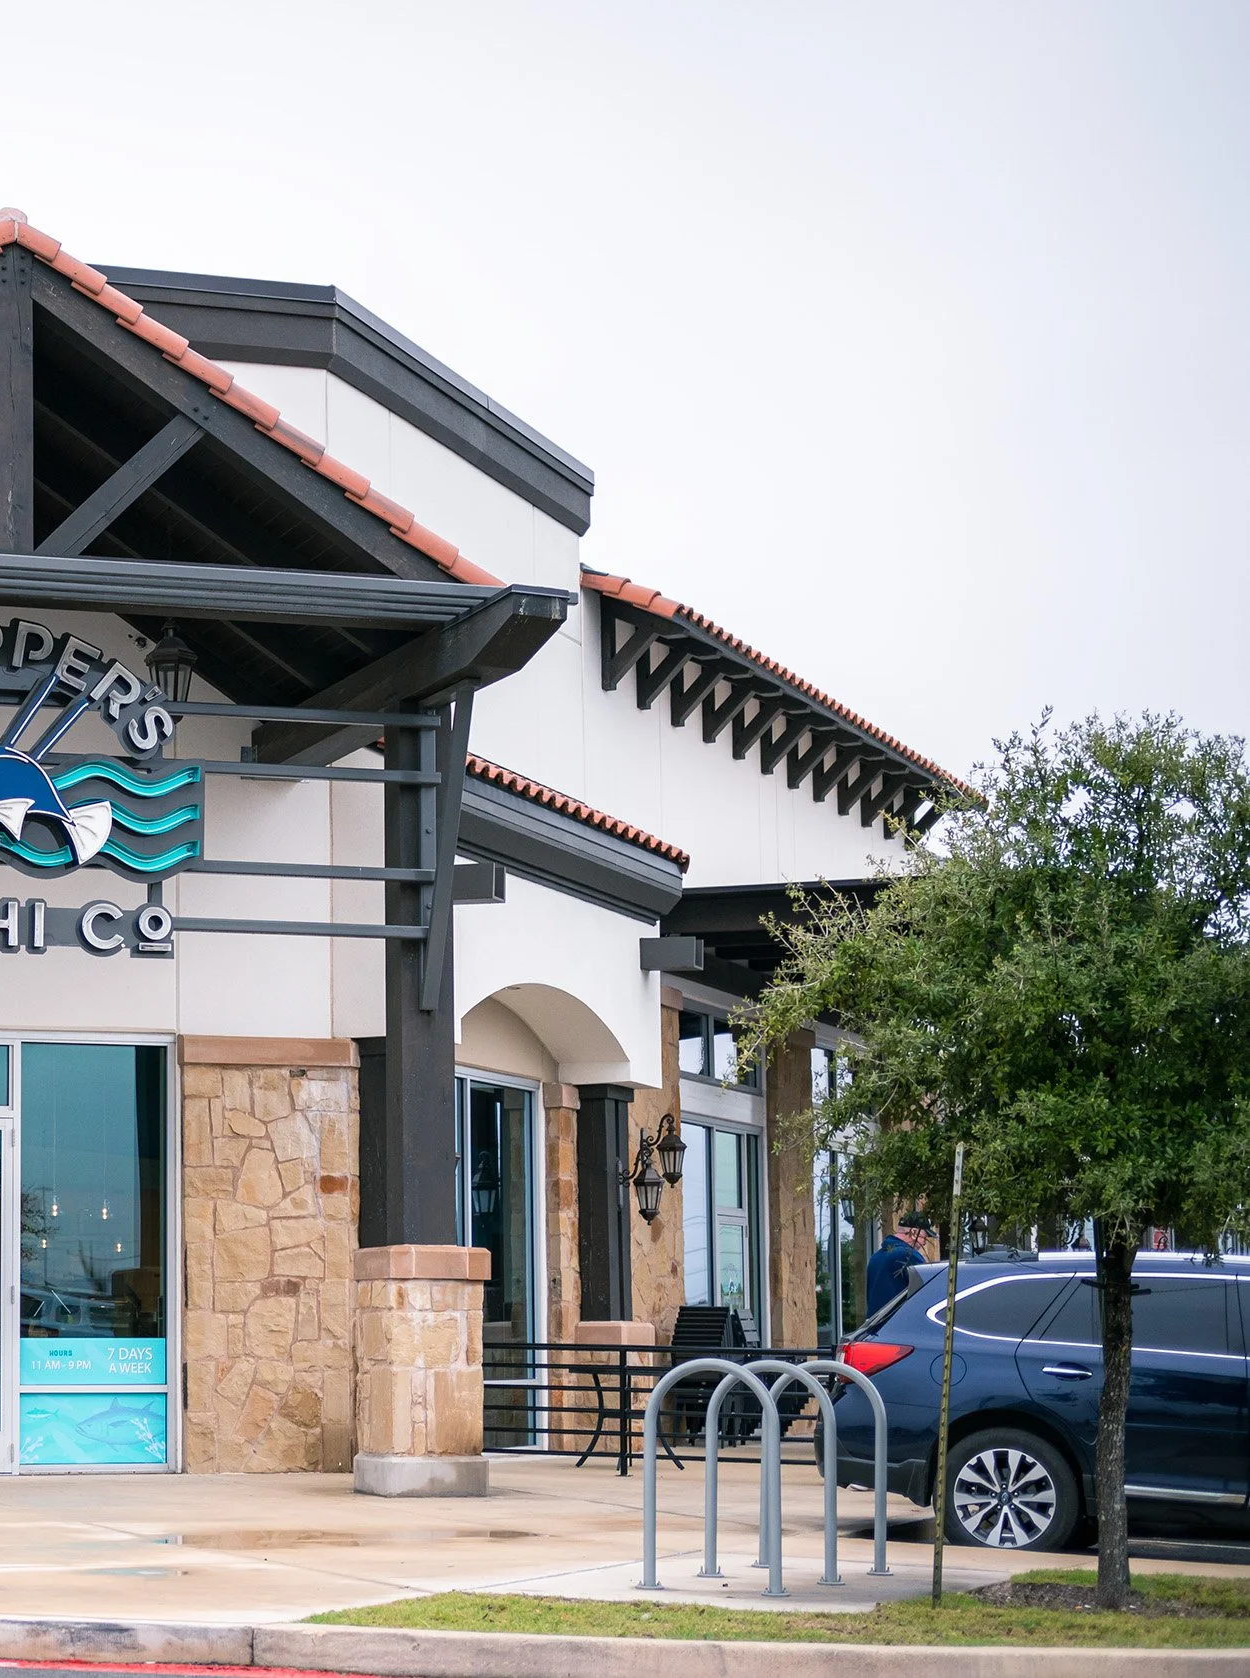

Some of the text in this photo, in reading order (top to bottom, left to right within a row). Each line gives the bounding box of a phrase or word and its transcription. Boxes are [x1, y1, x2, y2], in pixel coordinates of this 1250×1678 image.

[49, 1349, 73, 1357] HOURS
[107, 1347, 153, 1361] 7 DAYS
[31, 1360, 42, 1370] 11
[44, 1360, 61, 1370] AM
[69, 1360, 75, 1370] 9
[76, 1360, 92, 1370] PM
[108, 1362, 152, 1374] A WEEK
